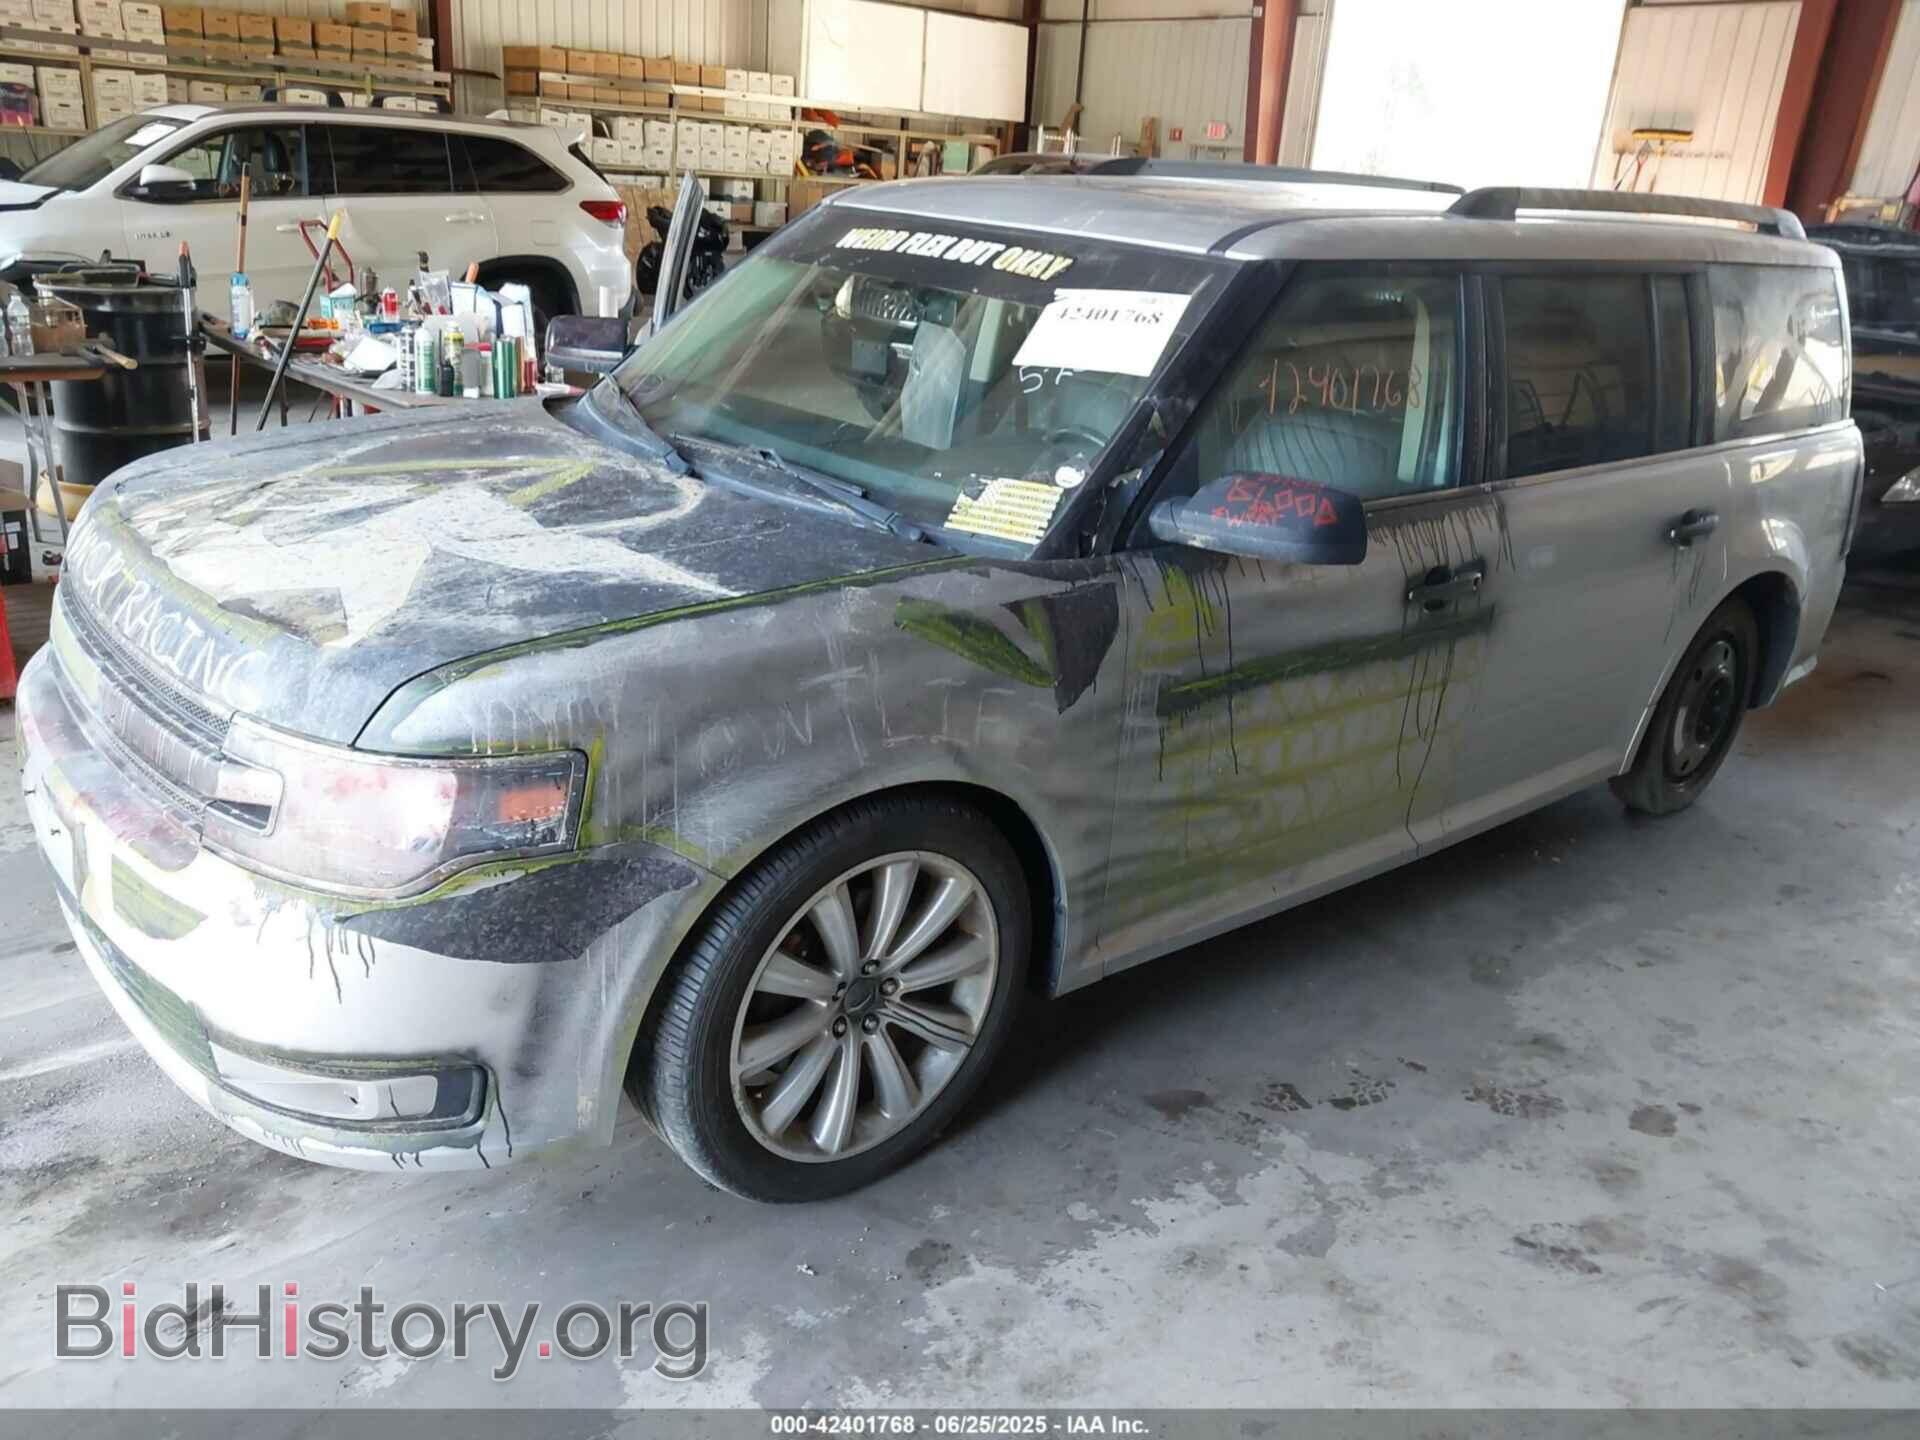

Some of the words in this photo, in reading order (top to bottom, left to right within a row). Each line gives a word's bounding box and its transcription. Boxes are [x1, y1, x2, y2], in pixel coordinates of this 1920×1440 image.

[835, 227, 909, 252] WEIRD
[895, 231, 958, 259] FLEX
[941, 238, 1006, 266] BUT
[991, 246, 1074, 282] OKAY
